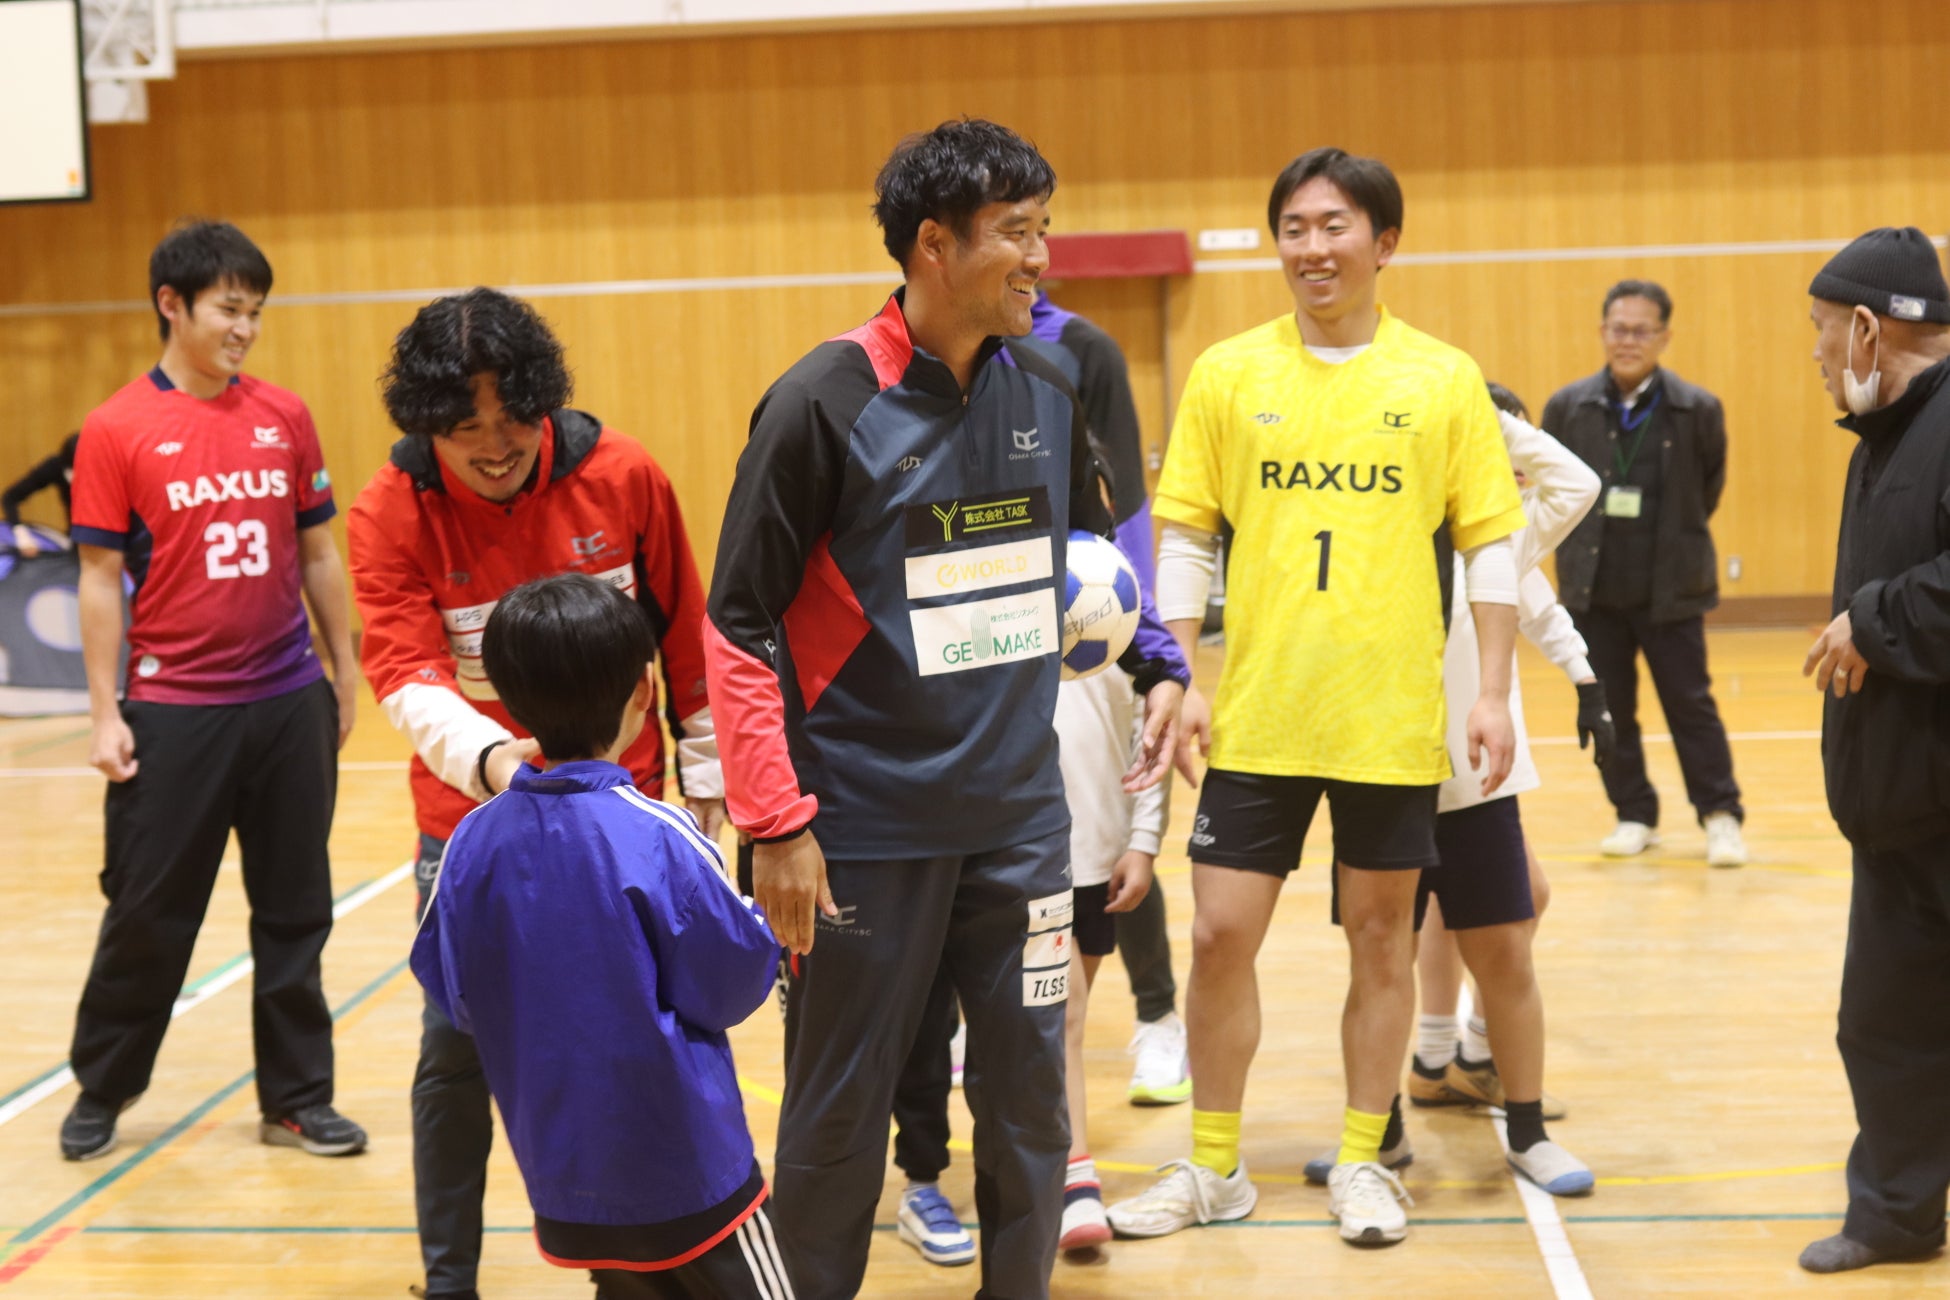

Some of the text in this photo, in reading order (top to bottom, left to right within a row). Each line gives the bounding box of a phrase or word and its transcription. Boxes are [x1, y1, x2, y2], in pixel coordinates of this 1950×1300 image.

[166, 469, 288, 511] RAXUS
[1261, 461, 1403, 494] RAXUS
[1005, 504, 1028, 519] TASK
[204, 519, 270, 580] 23
[1314, 530, 1332, 591] 1
[1033, 975, 1065, 998] TLSS
